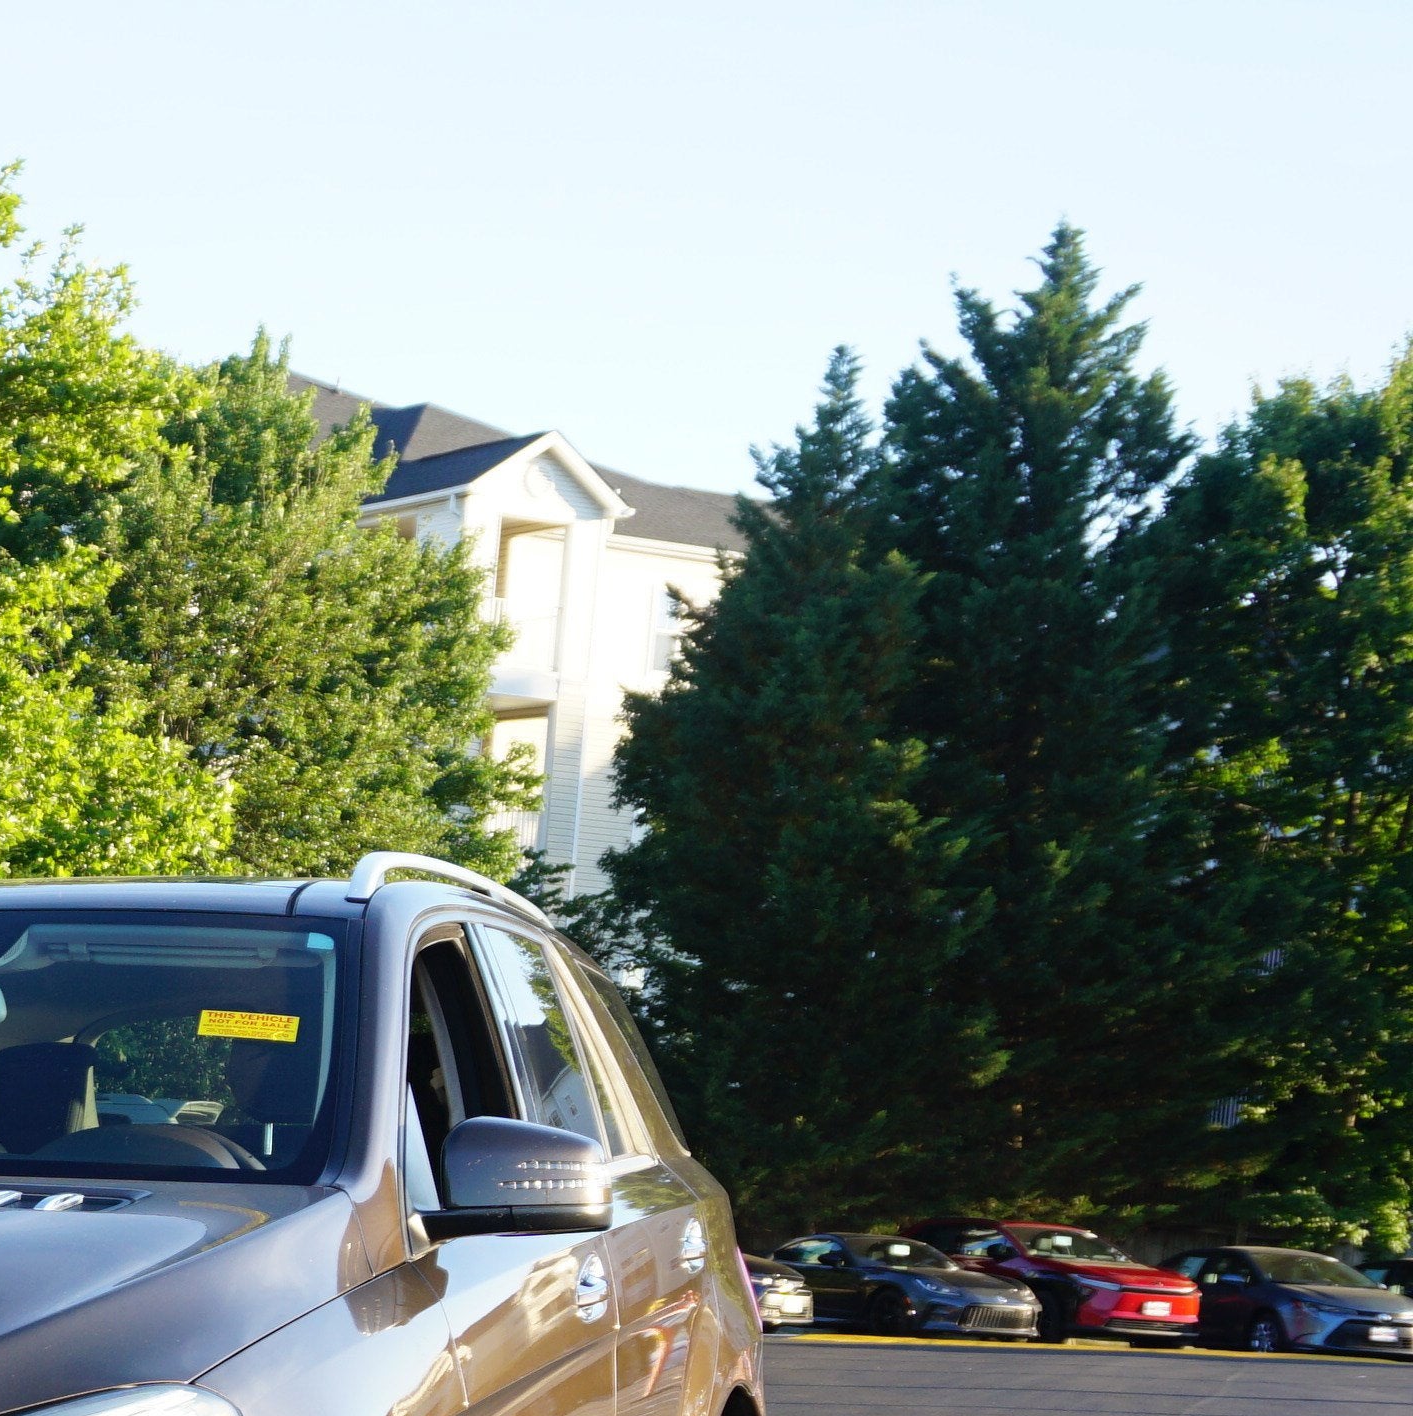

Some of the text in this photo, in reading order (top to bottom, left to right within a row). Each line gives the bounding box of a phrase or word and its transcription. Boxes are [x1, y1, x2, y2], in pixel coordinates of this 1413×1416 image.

[207, 1011, 295, 1023] THIS VEHICLE
[261, 1021, 291, 1029] SALE
